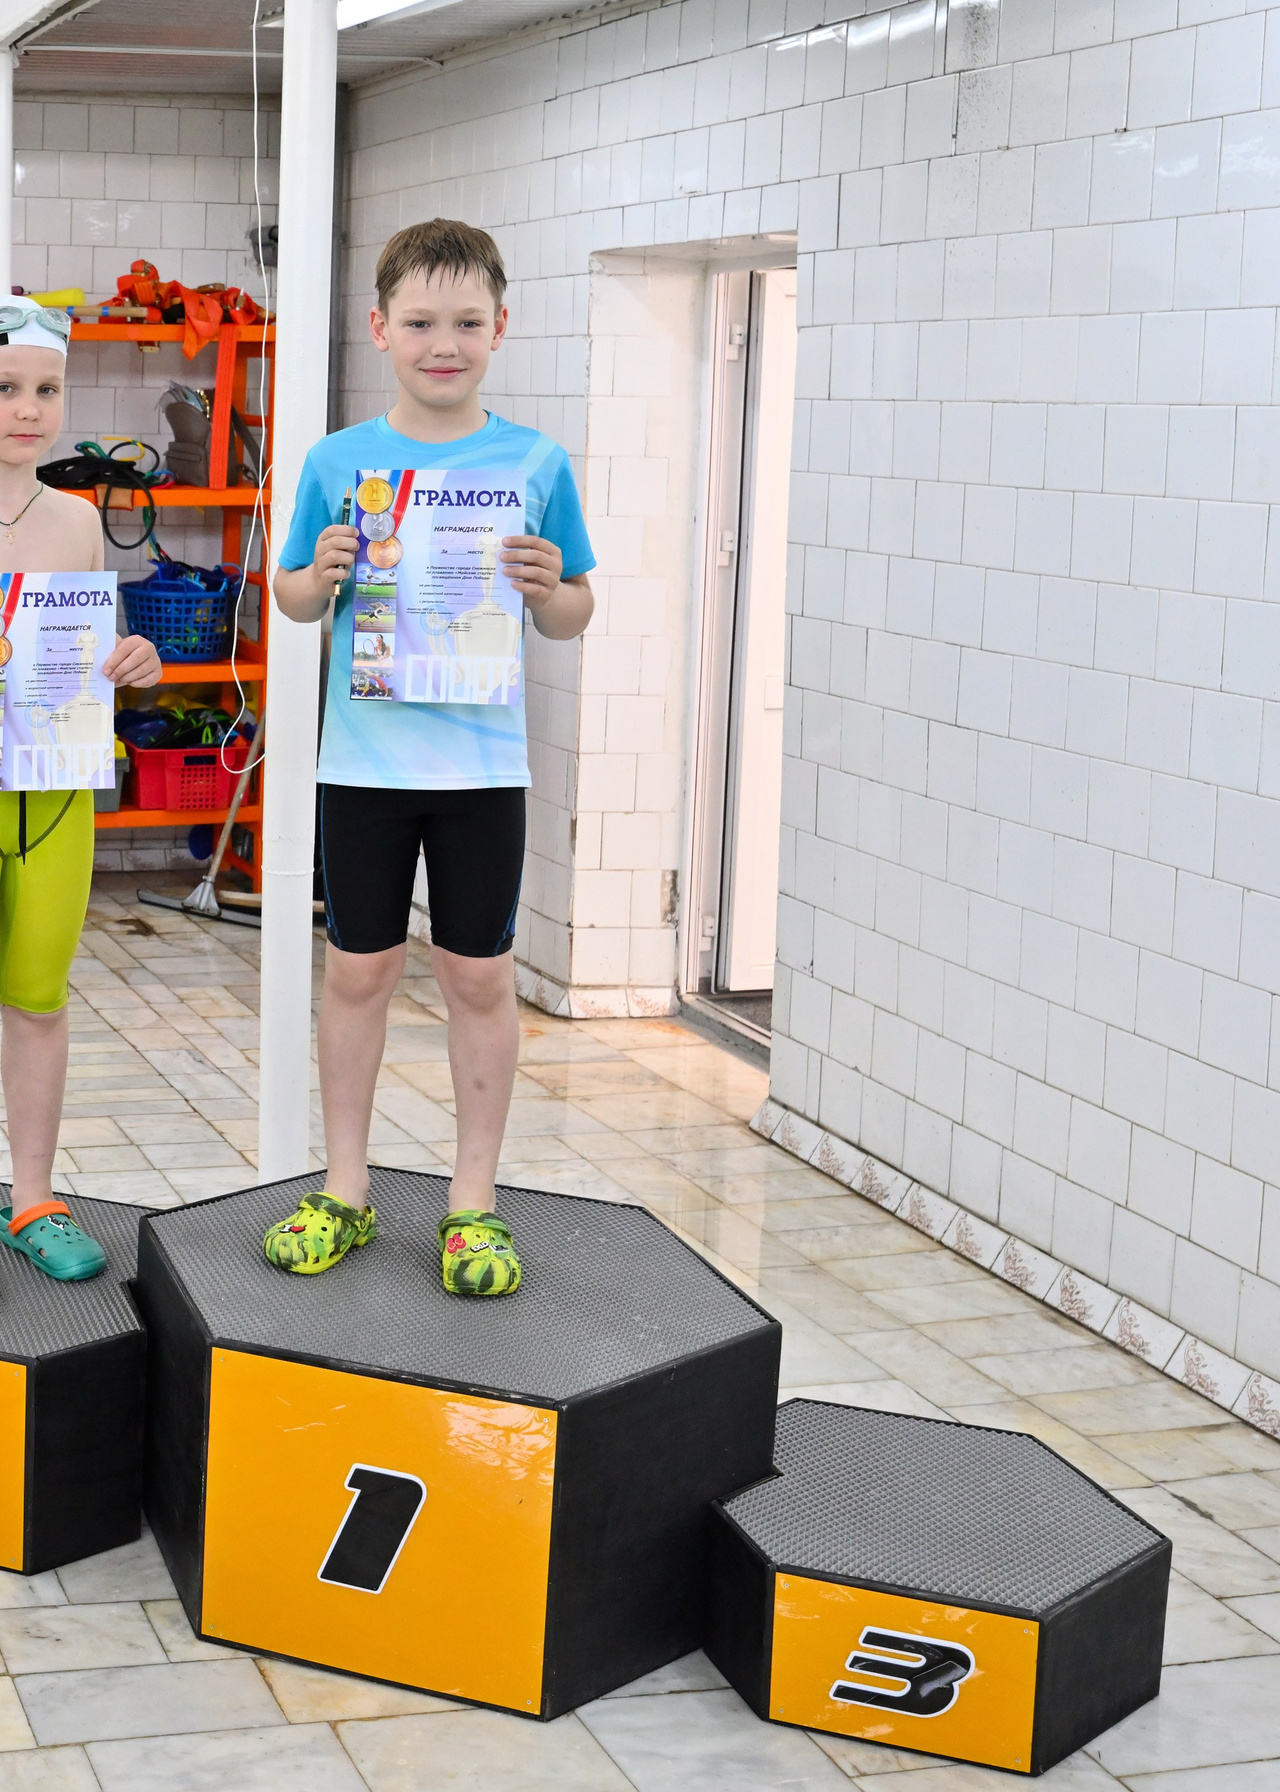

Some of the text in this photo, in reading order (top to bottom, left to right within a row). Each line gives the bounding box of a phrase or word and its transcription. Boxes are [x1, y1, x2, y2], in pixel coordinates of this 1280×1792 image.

[413, 489, 522, 508] ГРАМОТА
[22, 590, 113, 607] ГРАМОТА
[39, 624, 91, 632] НАГРАЖДАЕТСЯ
[404, 654, 517, 705] СПОРТ
[13, 742, 110, 790] СПОРТ
[317, 1462, 427, 1594] 1
[829, 1625, 975, 1718] 3
